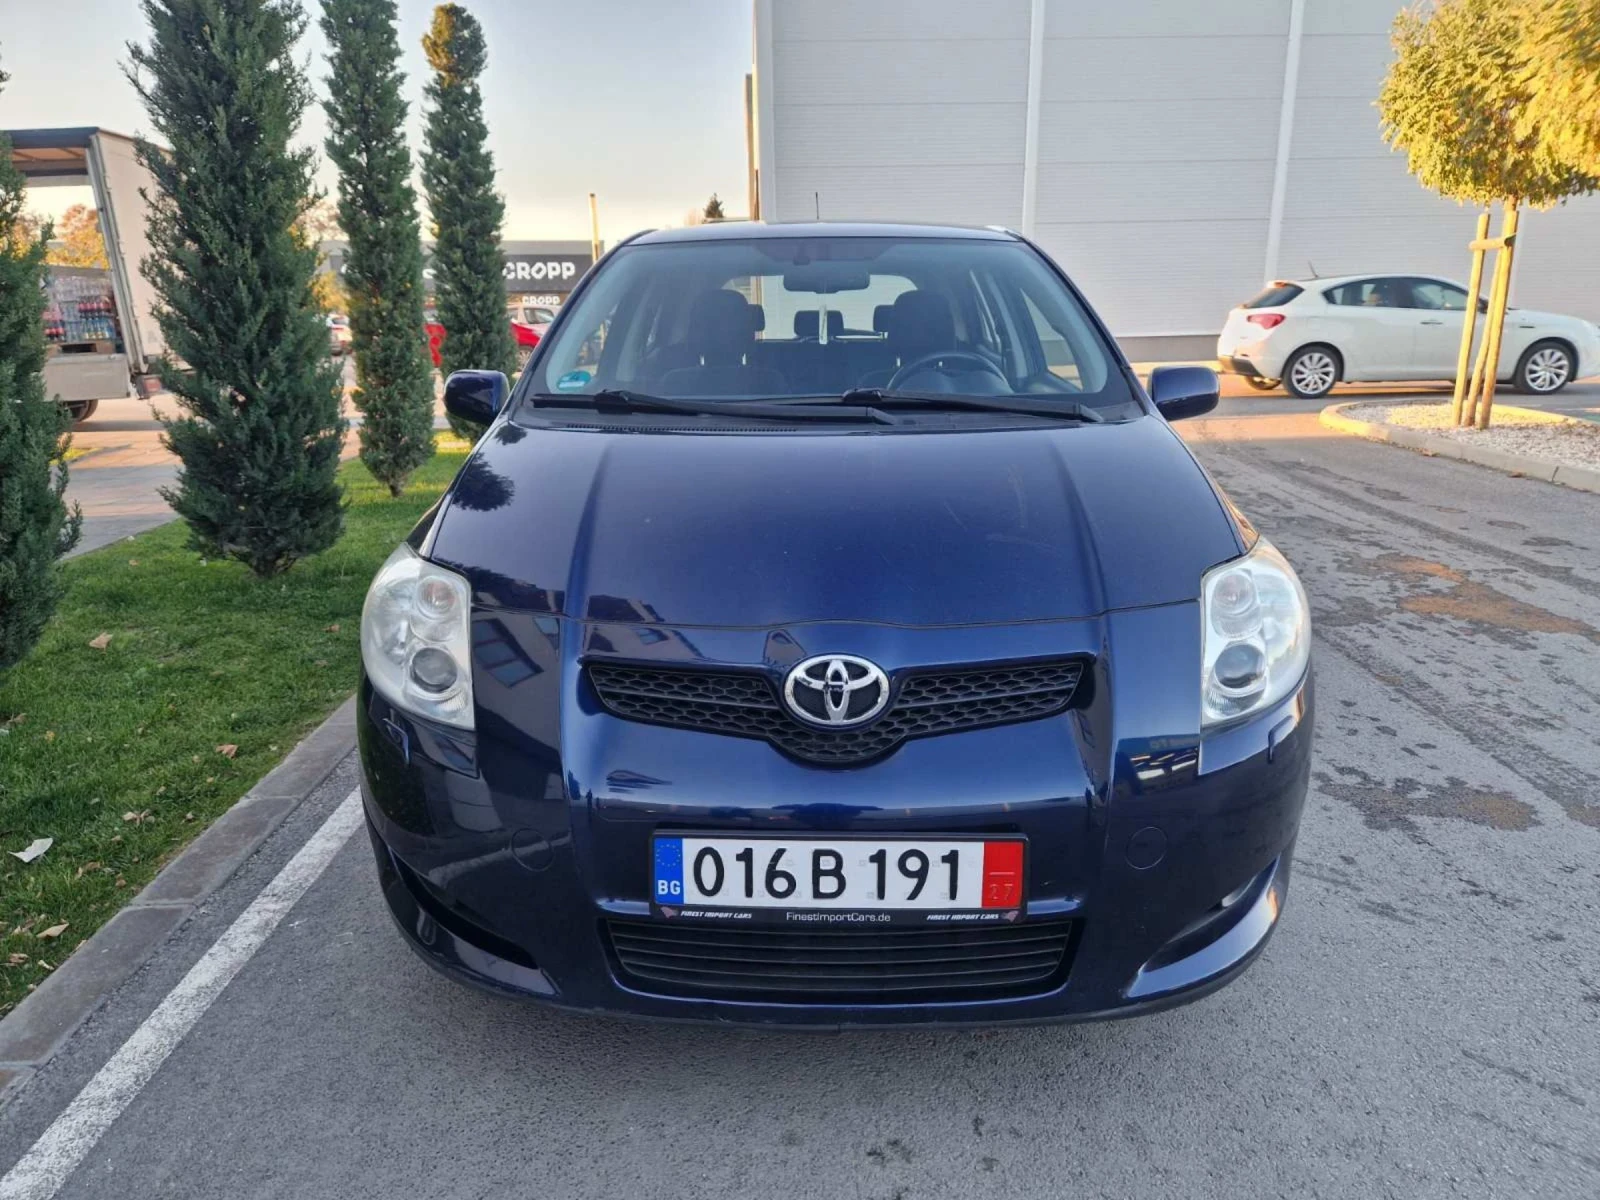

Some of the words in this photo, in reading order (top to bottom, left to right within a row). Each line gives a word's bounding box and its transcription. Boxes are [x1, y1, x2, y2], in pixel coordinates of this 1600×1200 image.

[502, 261, 576, 280] CROPP
[522, 295, 560, 305] CROPP
[693, 846, 796, 899] 016
[812, 848, 847, 900] B
[868, 848, 959, 901] 191
[657, 879, 681, 895] BG
[786, 911, 891, 923] FinestImportCars.de
